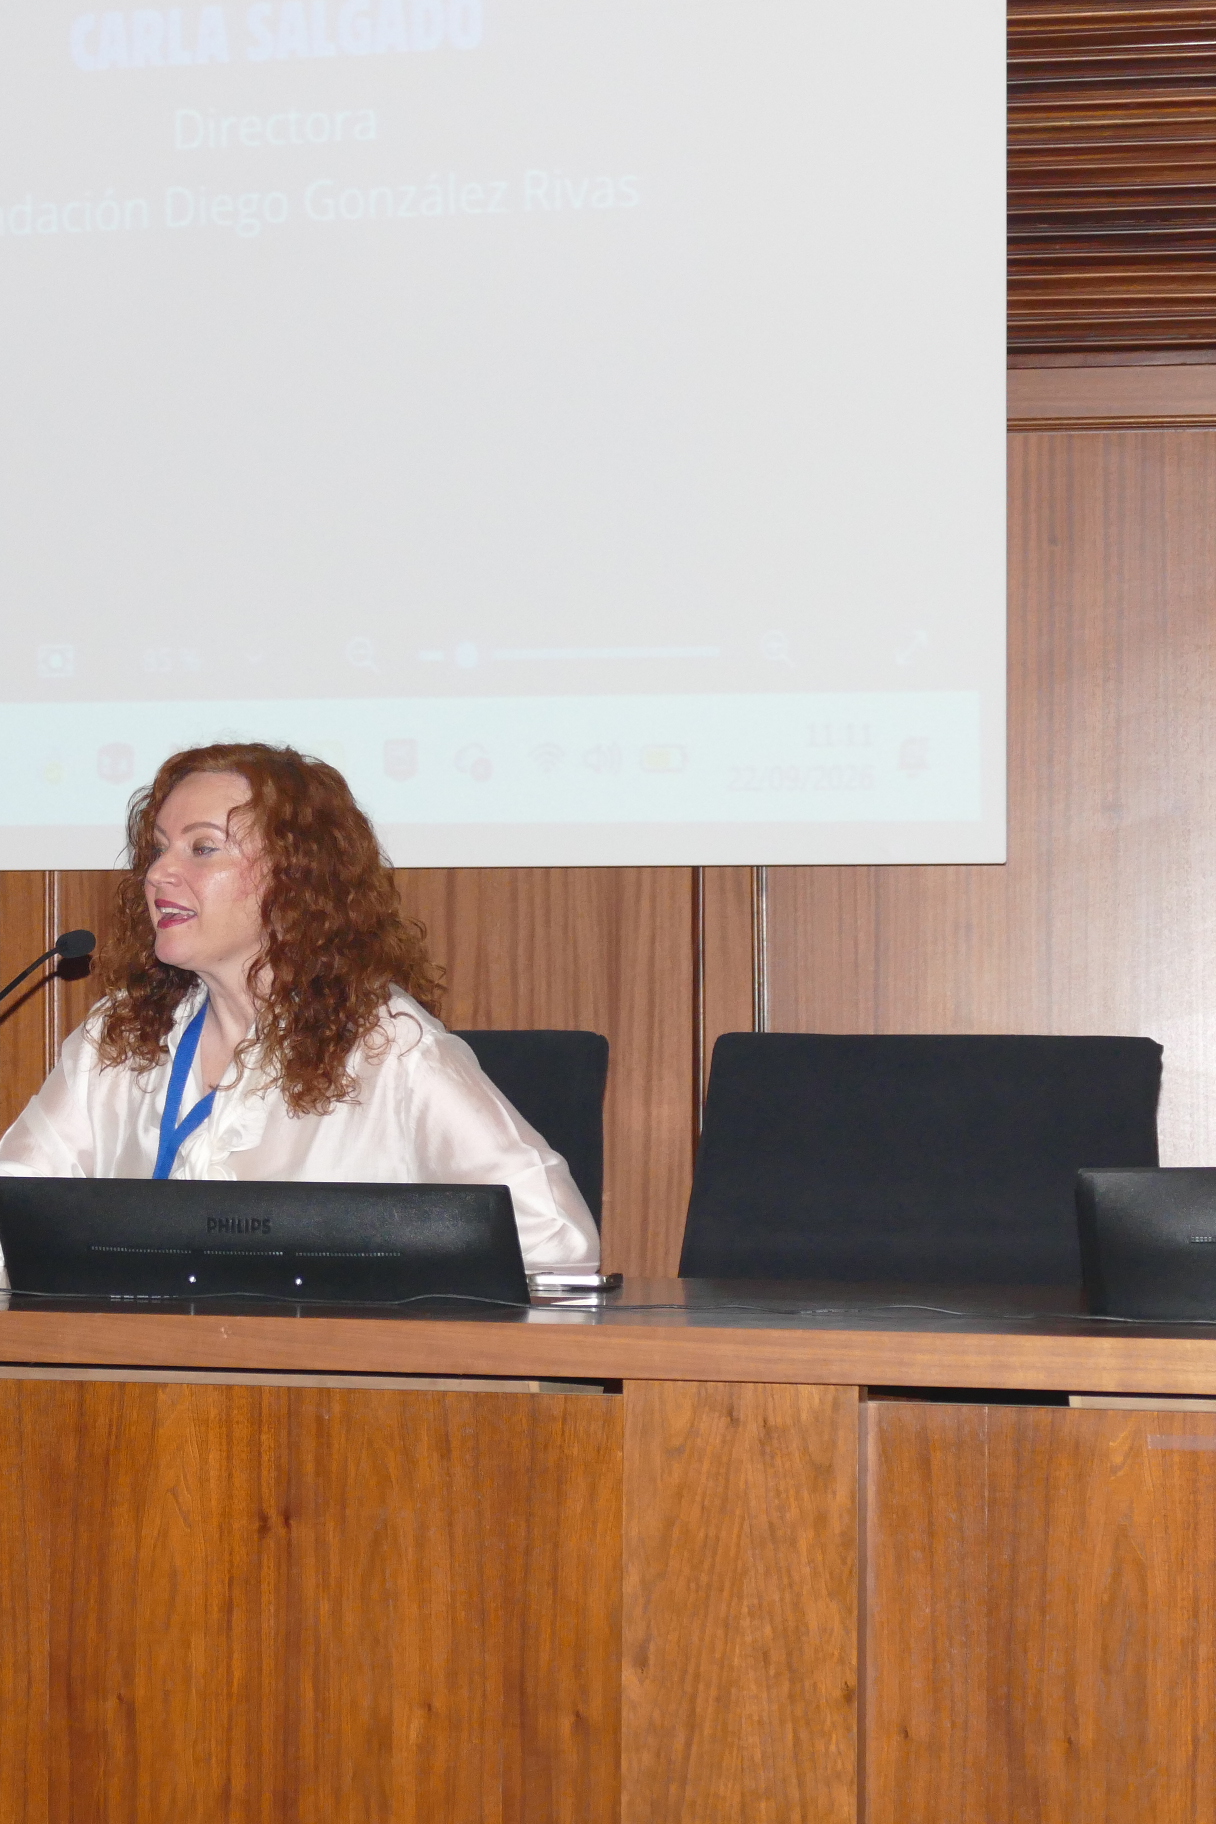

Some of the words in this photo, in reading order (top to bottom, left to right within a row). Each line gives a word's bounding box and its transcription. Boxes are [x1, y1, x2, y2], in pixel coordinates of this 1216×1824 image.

[70, 6, 230, 70] CARLA
[248, 0, 483, 61] SALGADO
[176, 109, 378, 149] Directora
[165, 186, 290, 238] Diego
[305, 172, 509, 221] González
[524, 169, 641, 210] Rivas
[206, 1217, 272, 1235] PHILIPS
